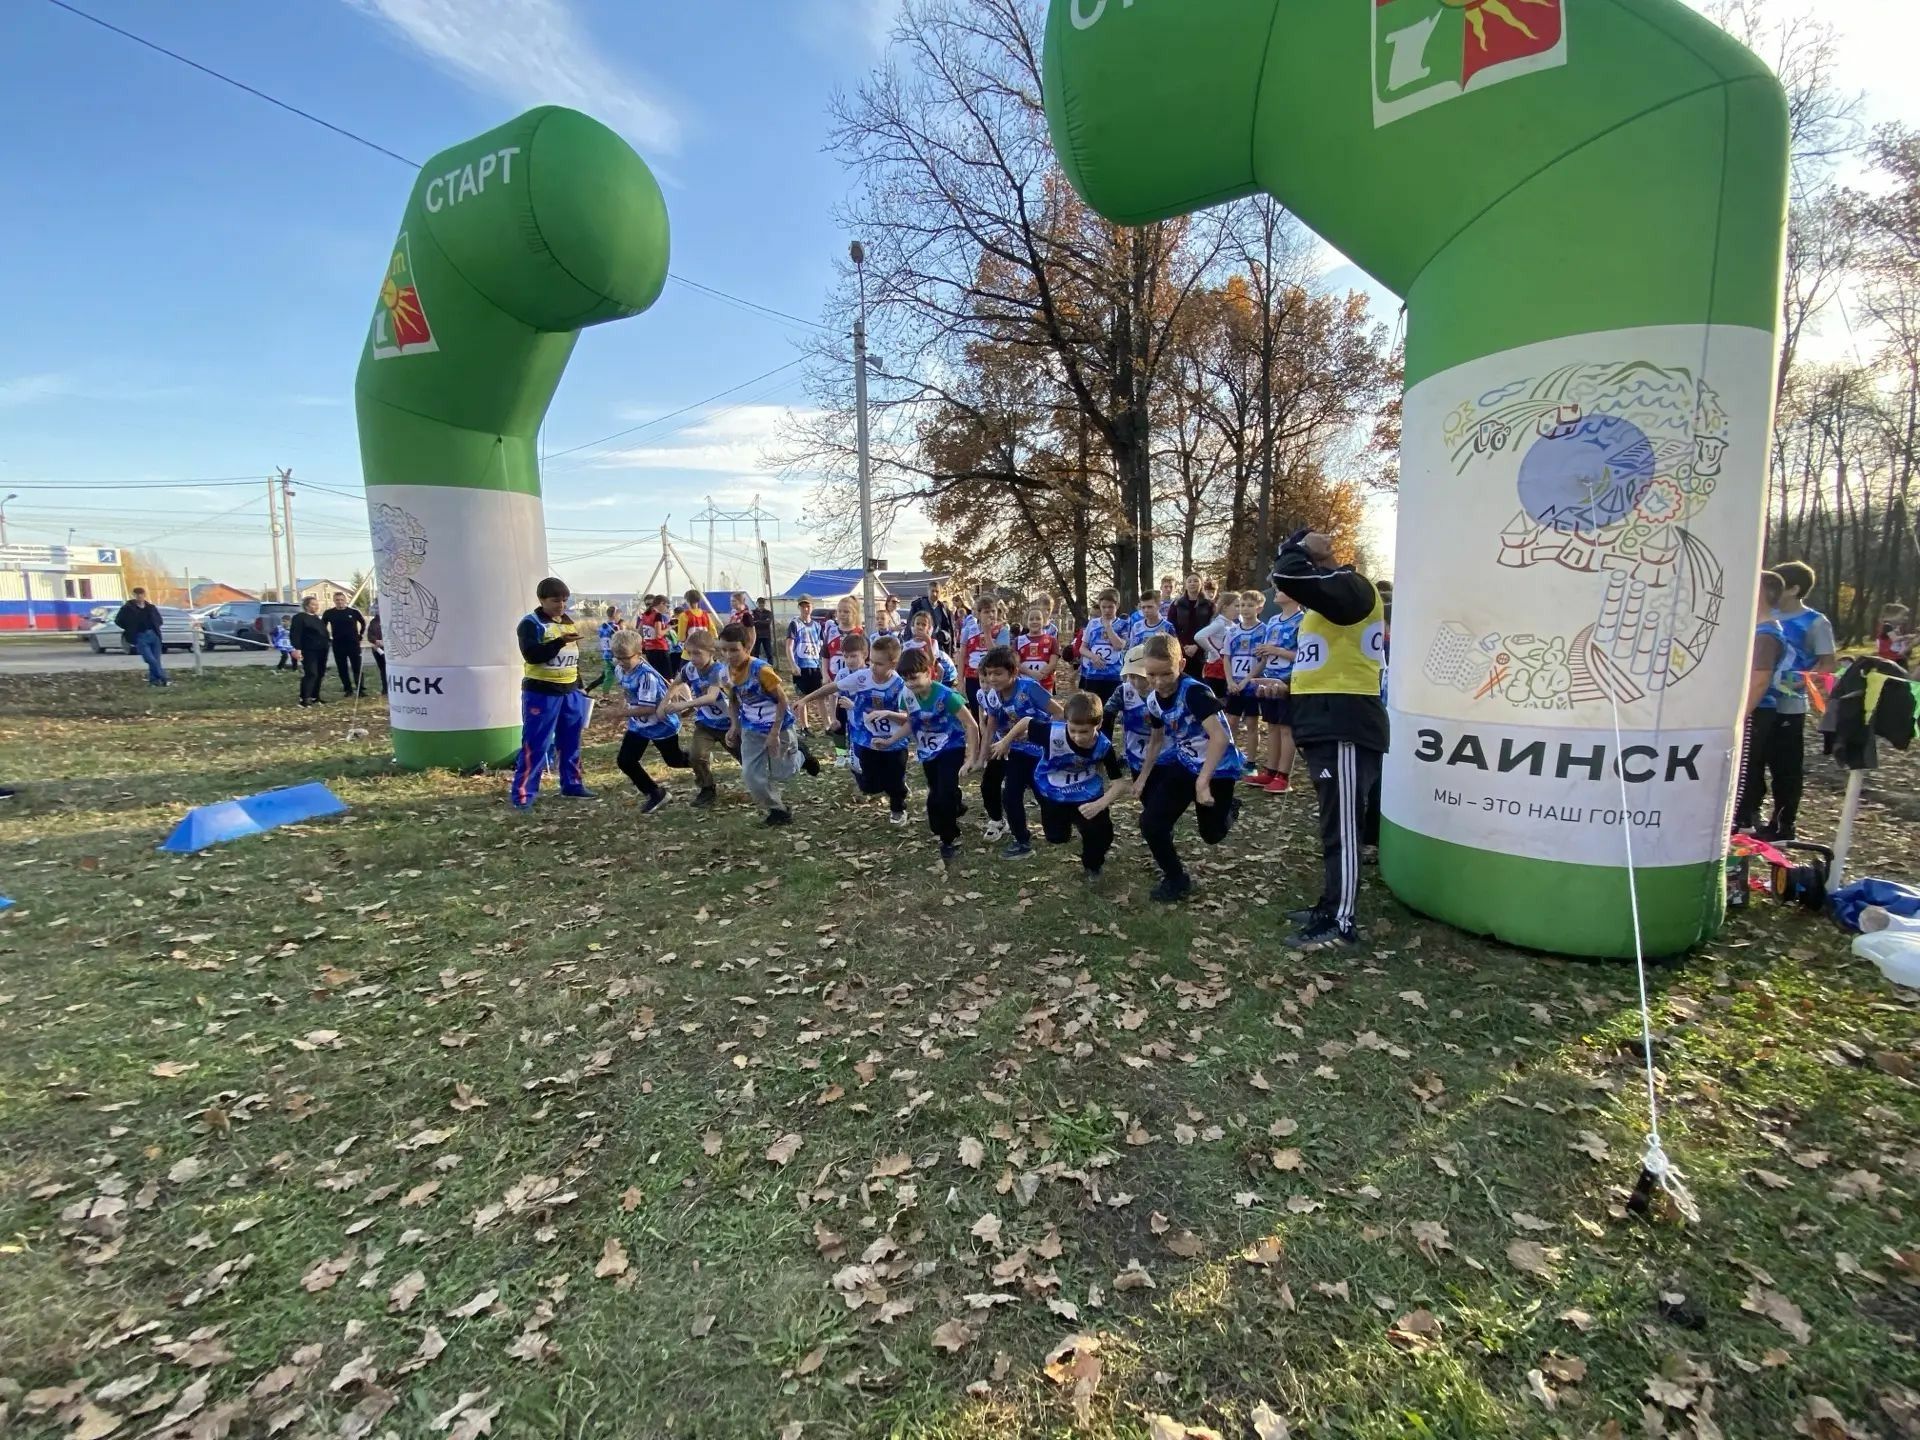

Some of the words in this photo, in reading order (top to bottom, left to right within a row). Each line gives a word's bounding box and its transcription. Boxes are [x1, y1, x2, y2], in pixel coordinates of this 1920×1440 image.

[425, 147, 521, 213] СТАРТ
[1234, 659, 1251, 674] 74
[871, 717, 892, 733] 18
[920, 735, 938, 751] 16
[1414, 728, 1704, 783] ЗАИНСК
[1434, 788, 1462, 806] МЫ
[1482, 797, 1521, 816] ЭТО
[1528, 804, 1581, 823] НАШ
[1589, 808, 1661, 828] ГОРОД
